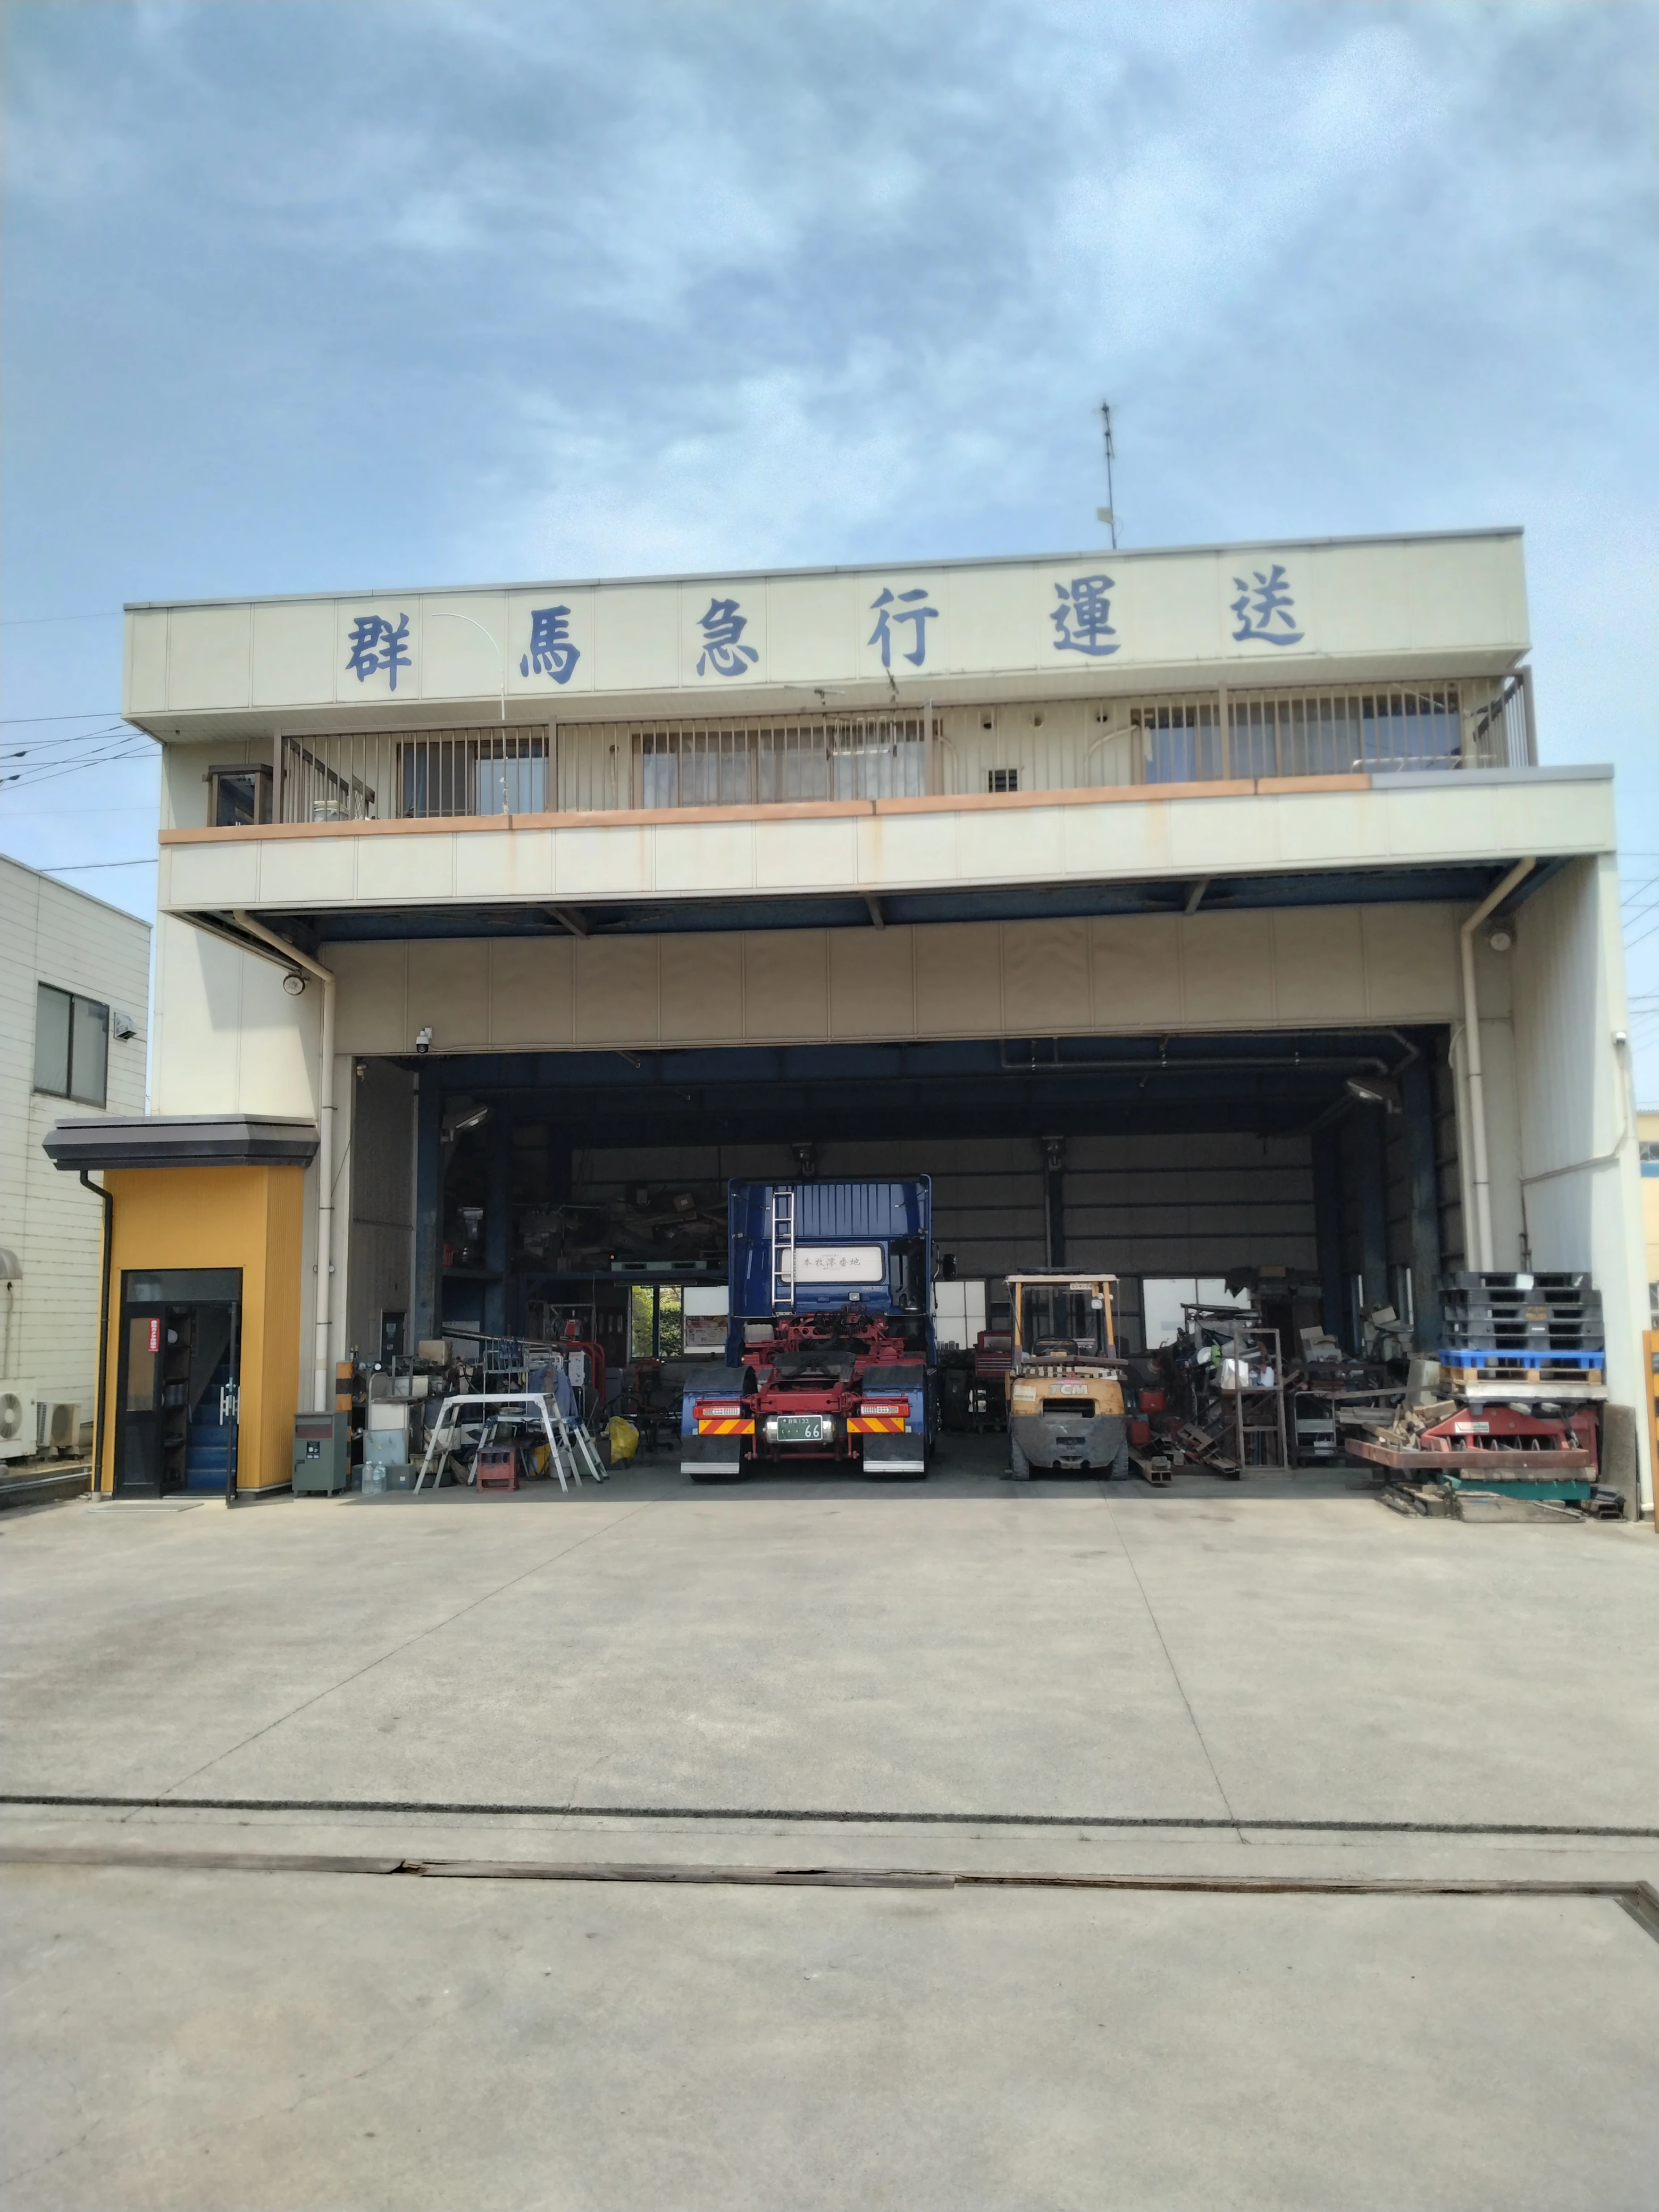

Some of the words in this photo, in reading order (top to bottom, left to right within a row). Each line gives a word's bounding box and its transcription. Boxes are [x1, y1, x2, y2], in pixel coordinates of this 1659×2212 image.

[346, 565, 1304, 692] 群馬急行運送
[1050, 1384, 1088, 1394] TCM
